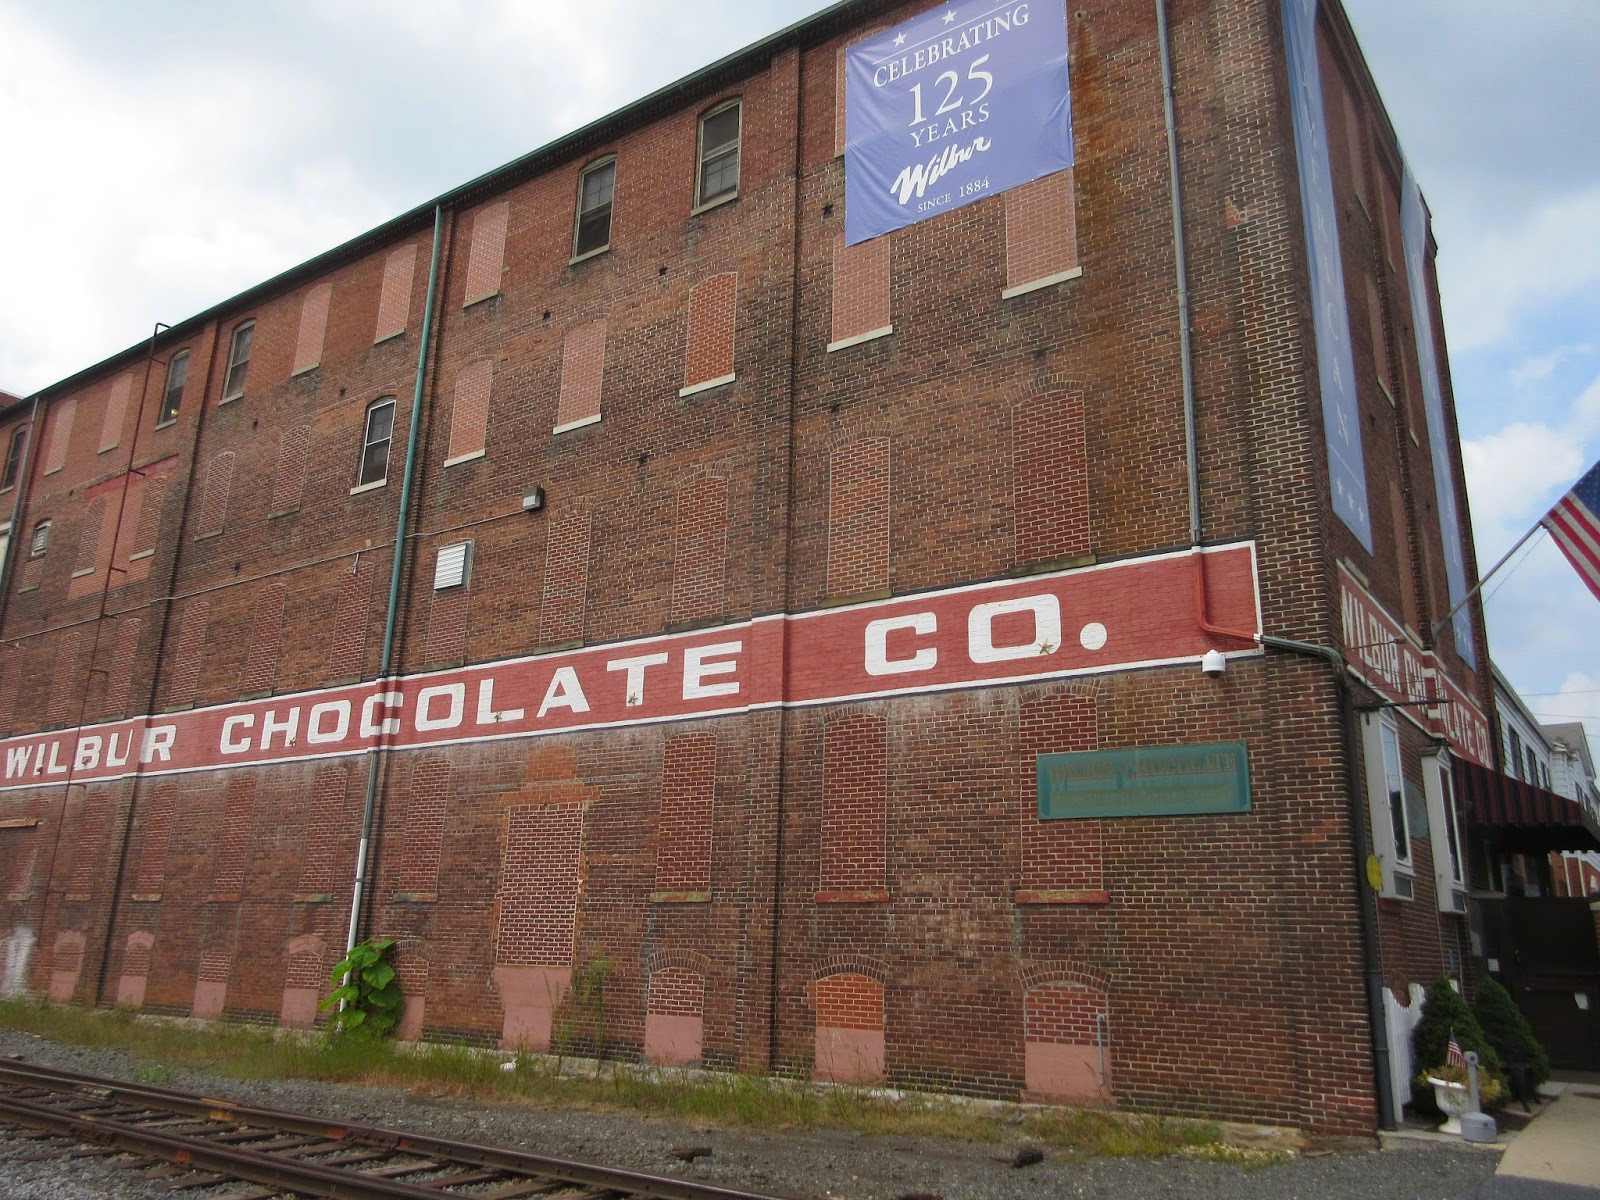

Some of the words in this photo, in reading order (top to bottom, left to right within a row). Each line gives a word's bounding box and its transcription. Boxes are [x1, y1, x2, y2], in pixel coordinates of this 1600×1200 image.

[873, 5, 1030, 88] CELEBRATING
[908, 54, 994, 126] 125
[910, 103, 990, 149] YEARS
[890, 136, 992, 205] Wilbur
[917, 193, 952, 213] SINCE
[959, 177, 990, 198] 1884
[1341, 585, 1401, 693] WILBUR
[6, 724, 177, 779] WILBUR
[220, 641, 742, 754] CHOCOLATE
[865, 593, 1107, 676] CO.
